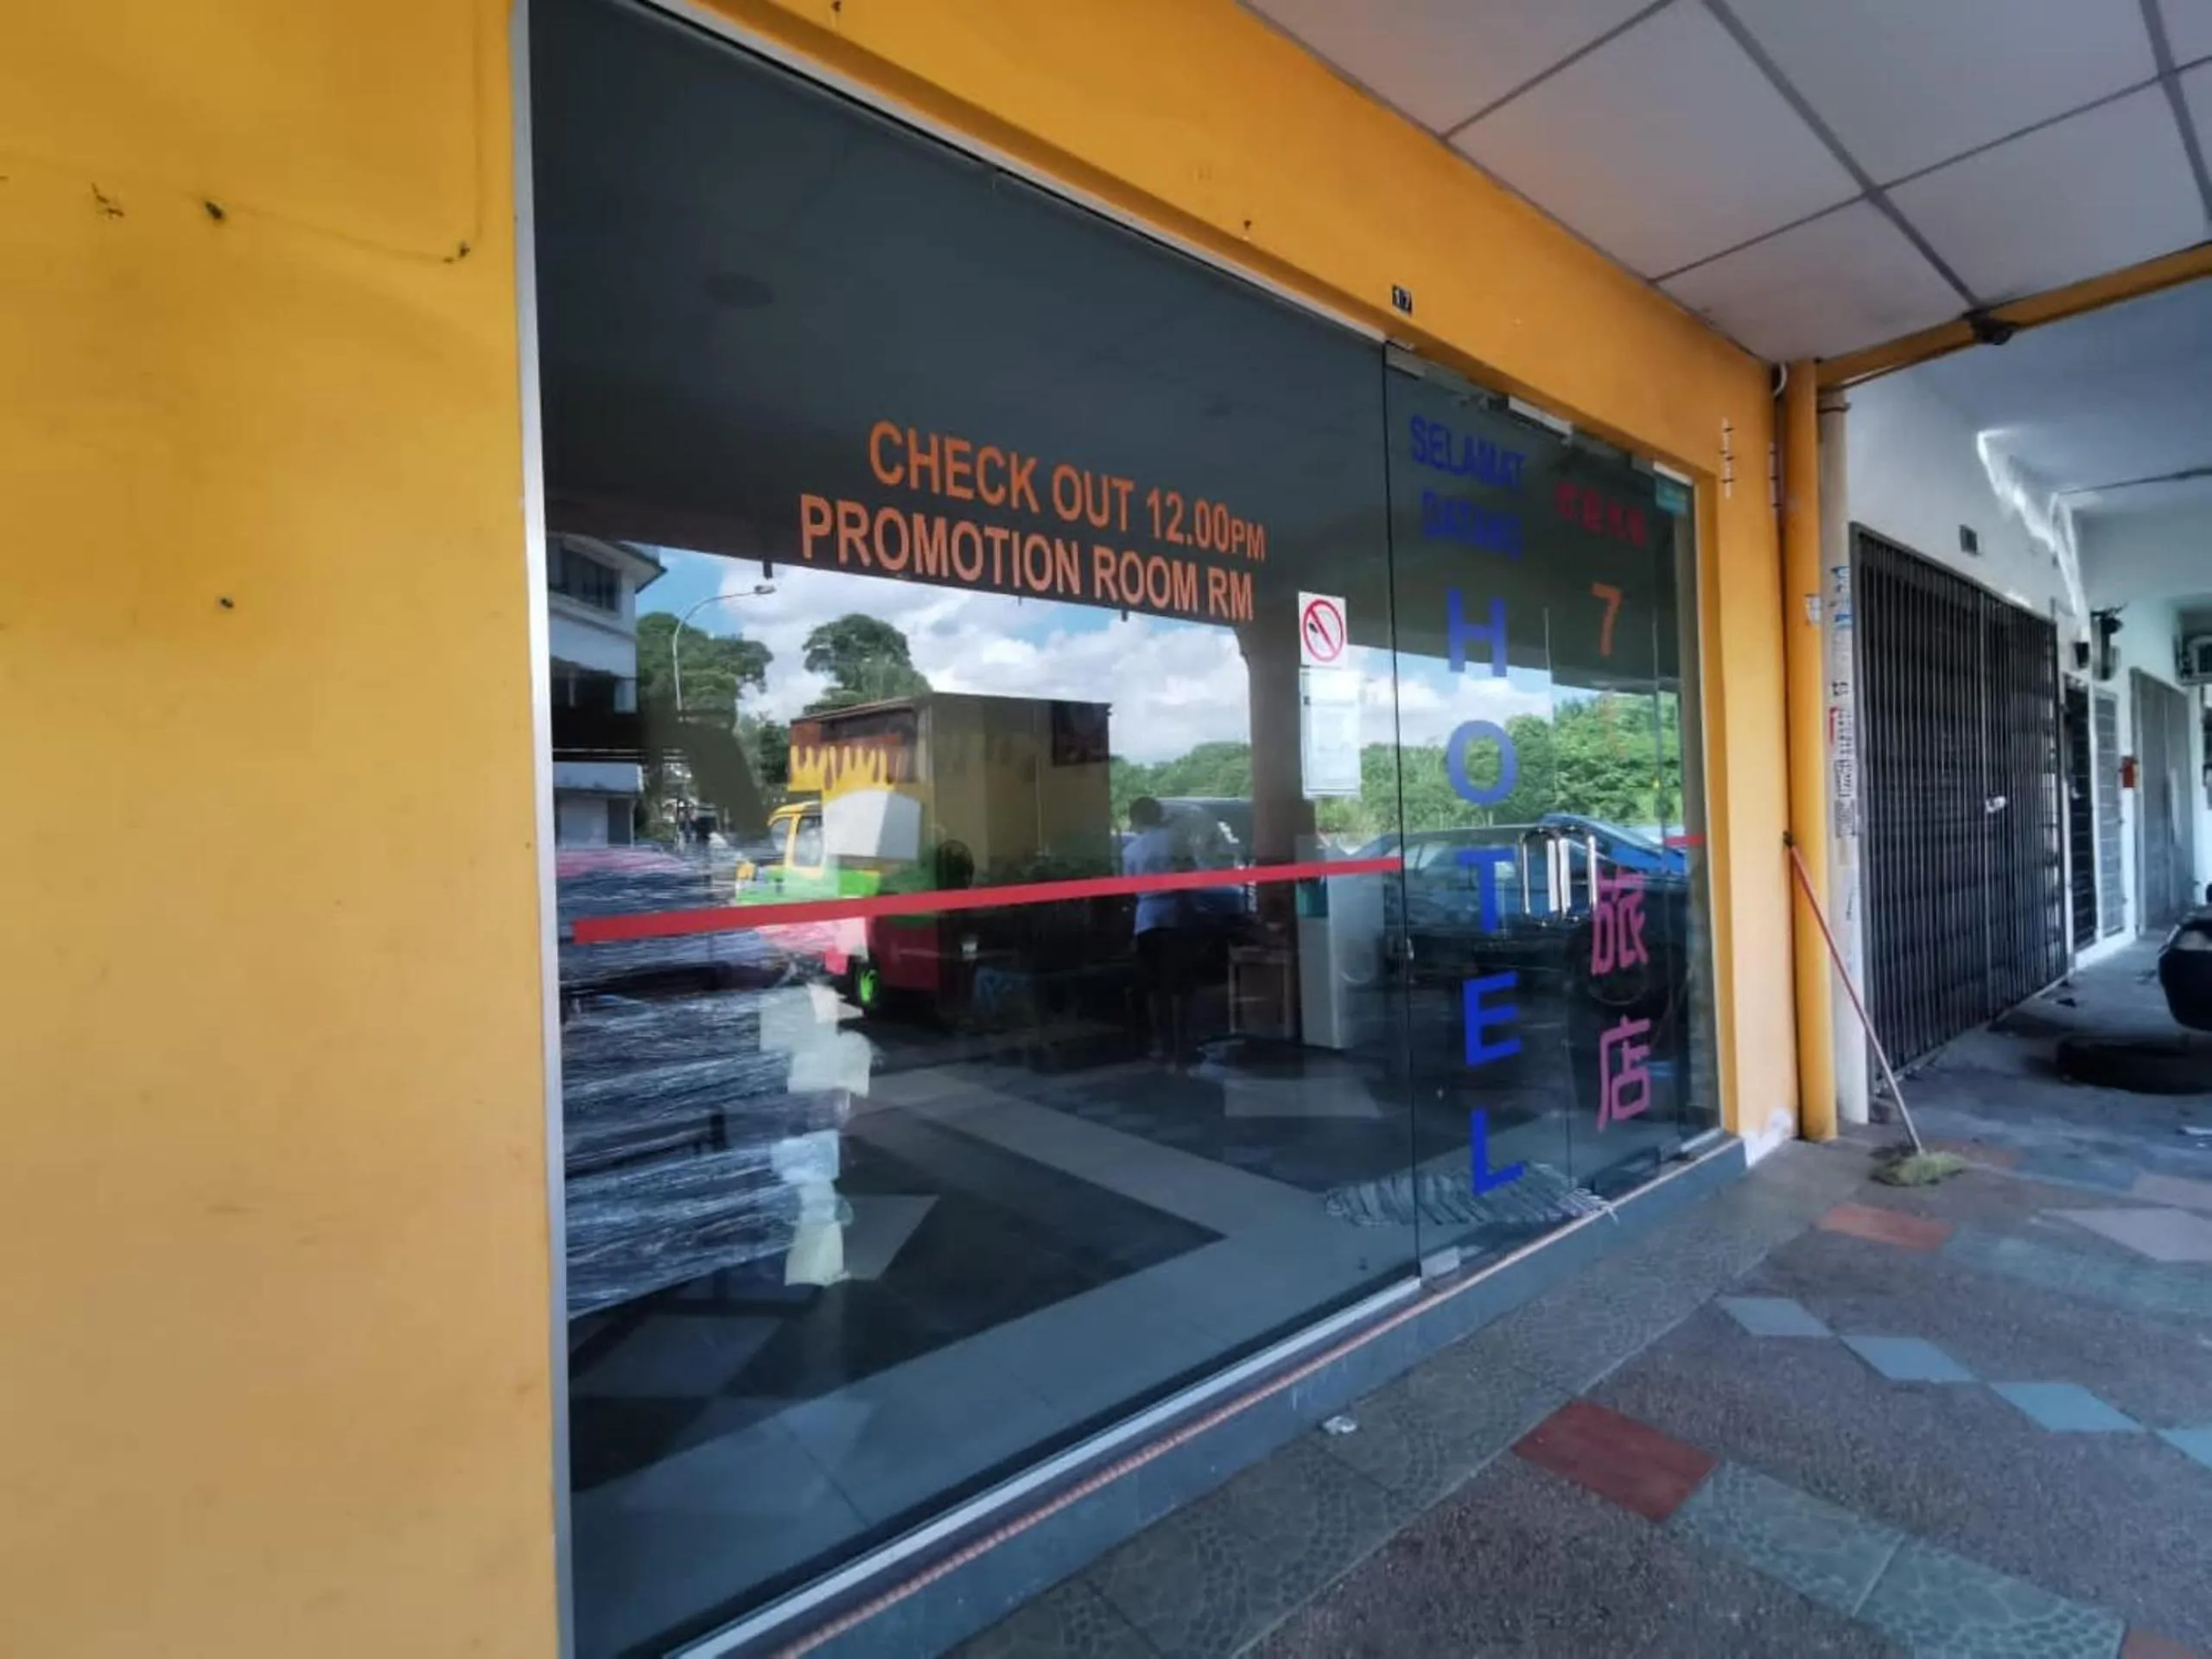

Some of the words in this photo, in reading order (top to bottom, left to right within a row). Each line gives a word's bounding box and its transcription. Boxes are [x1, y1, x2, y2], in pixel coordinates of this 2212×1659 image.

[800, 493, 1081, 595] PROMOTION
[1093, 546, 1198, 612] ROOM
[1209, 568, 1254, 621] RM
[869, 420, 1039, 513] CHECK
[1052, 464, 1135, 531] OUT
[1147, 487, 1265, 562] 12.00PM
[1590, 582, 1622, 658] 7
[1446, 588, 1527, 1198] HOTEL
[1590, 864, 1652, 1134] 旅店
